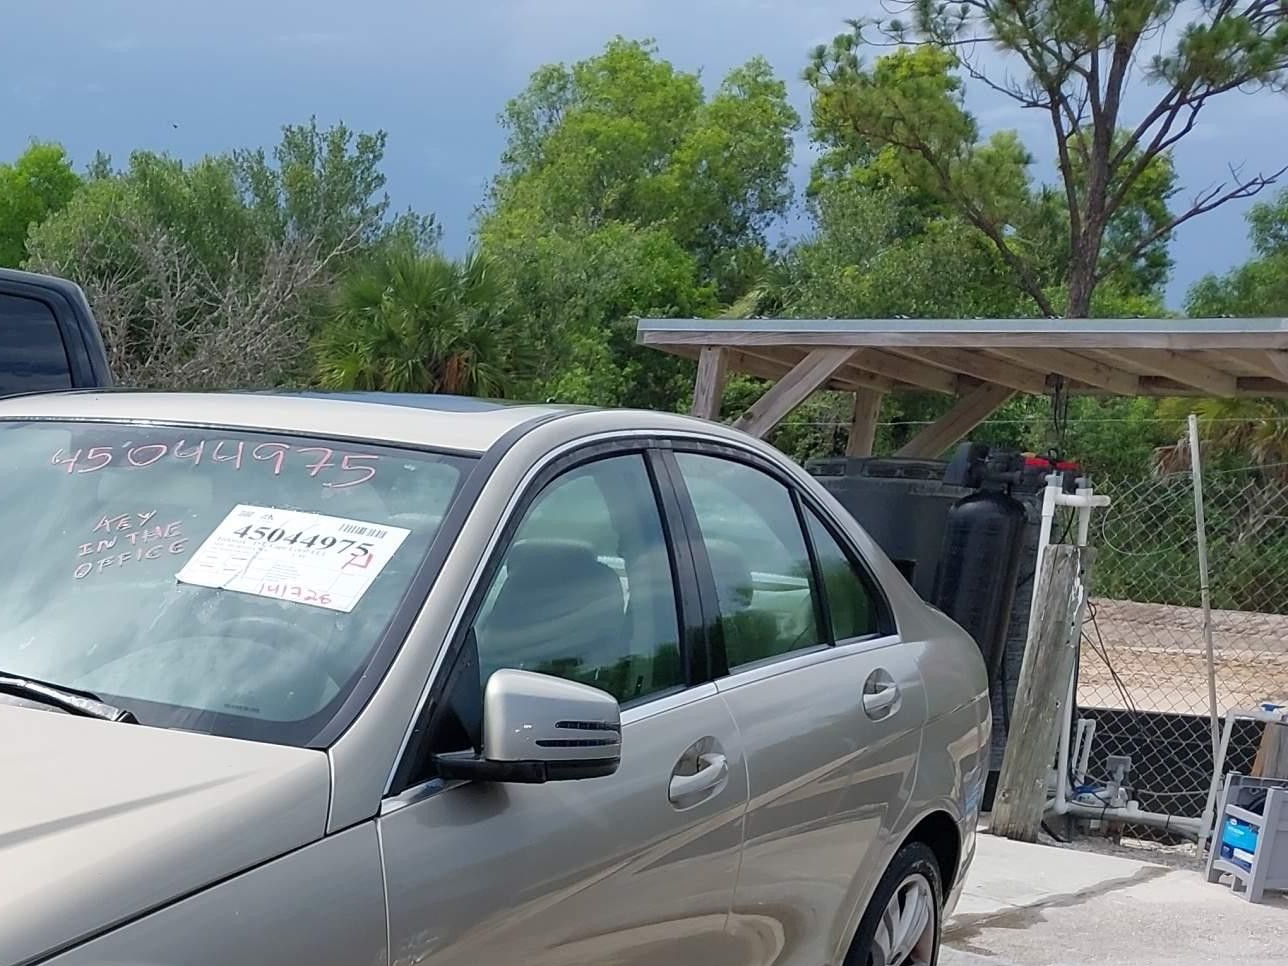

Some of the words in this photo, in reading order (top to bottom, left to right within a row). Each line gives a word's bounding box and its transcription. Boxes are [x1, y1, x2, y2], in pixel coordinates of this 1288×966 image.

[51, 438, 380, 489] 45044975
[74, 537, 190, 579] OFFICE
[79, 536, 118, 557] IN
[125, 521, 183, 545] THE
[233, 523, 374, 557] 45044975
